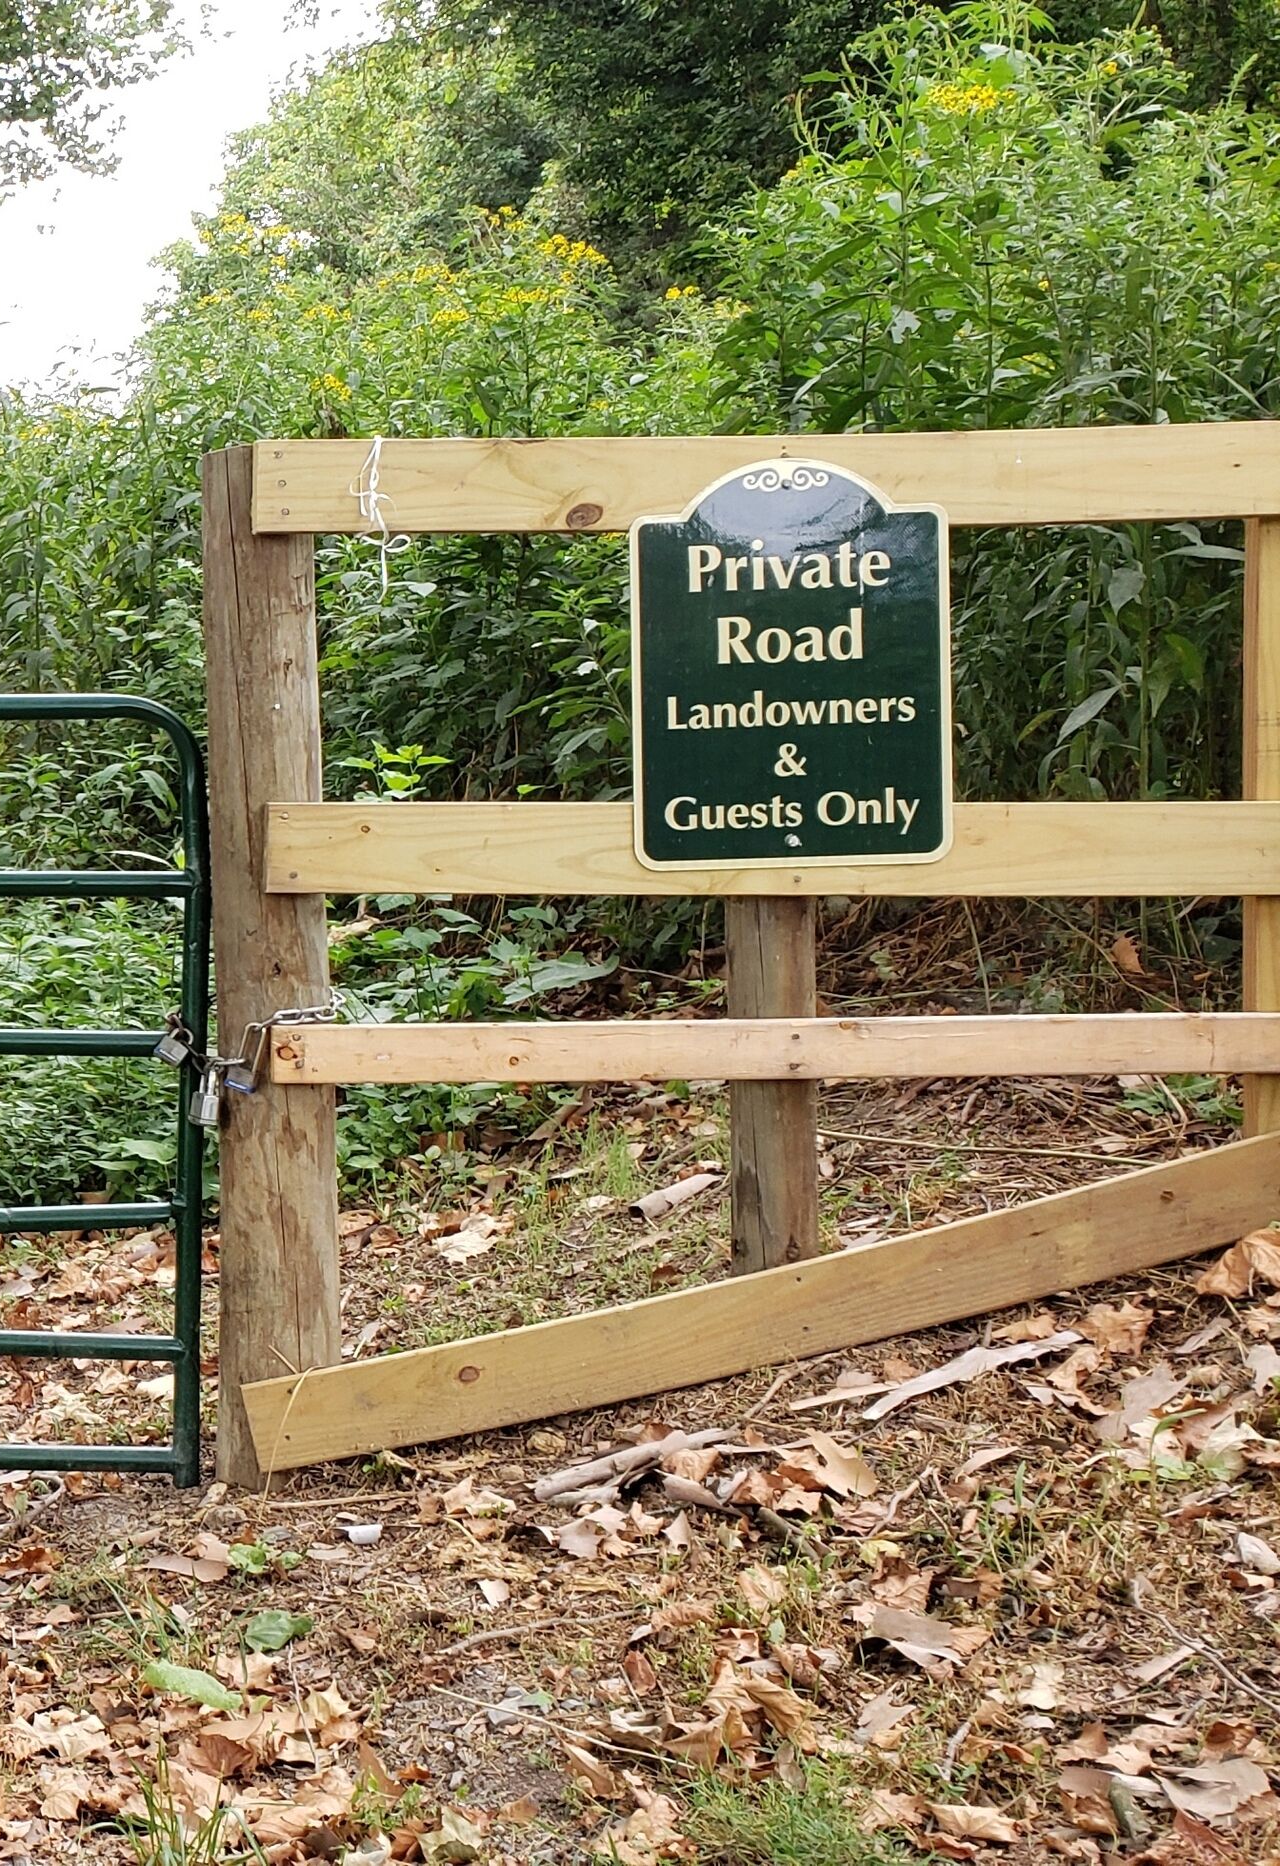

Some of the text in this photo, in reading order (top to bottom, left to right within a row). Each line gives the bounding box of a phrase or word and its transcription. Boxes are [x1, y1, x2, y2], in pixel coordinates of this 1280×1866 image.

[687, 538, 891, 593] Private
[716, 606, 864, 665] Road
[666, 689, 917, 730] Landowners
[773, 742, 808, 777] &
[663, 786, 921, 835] Guests Only
